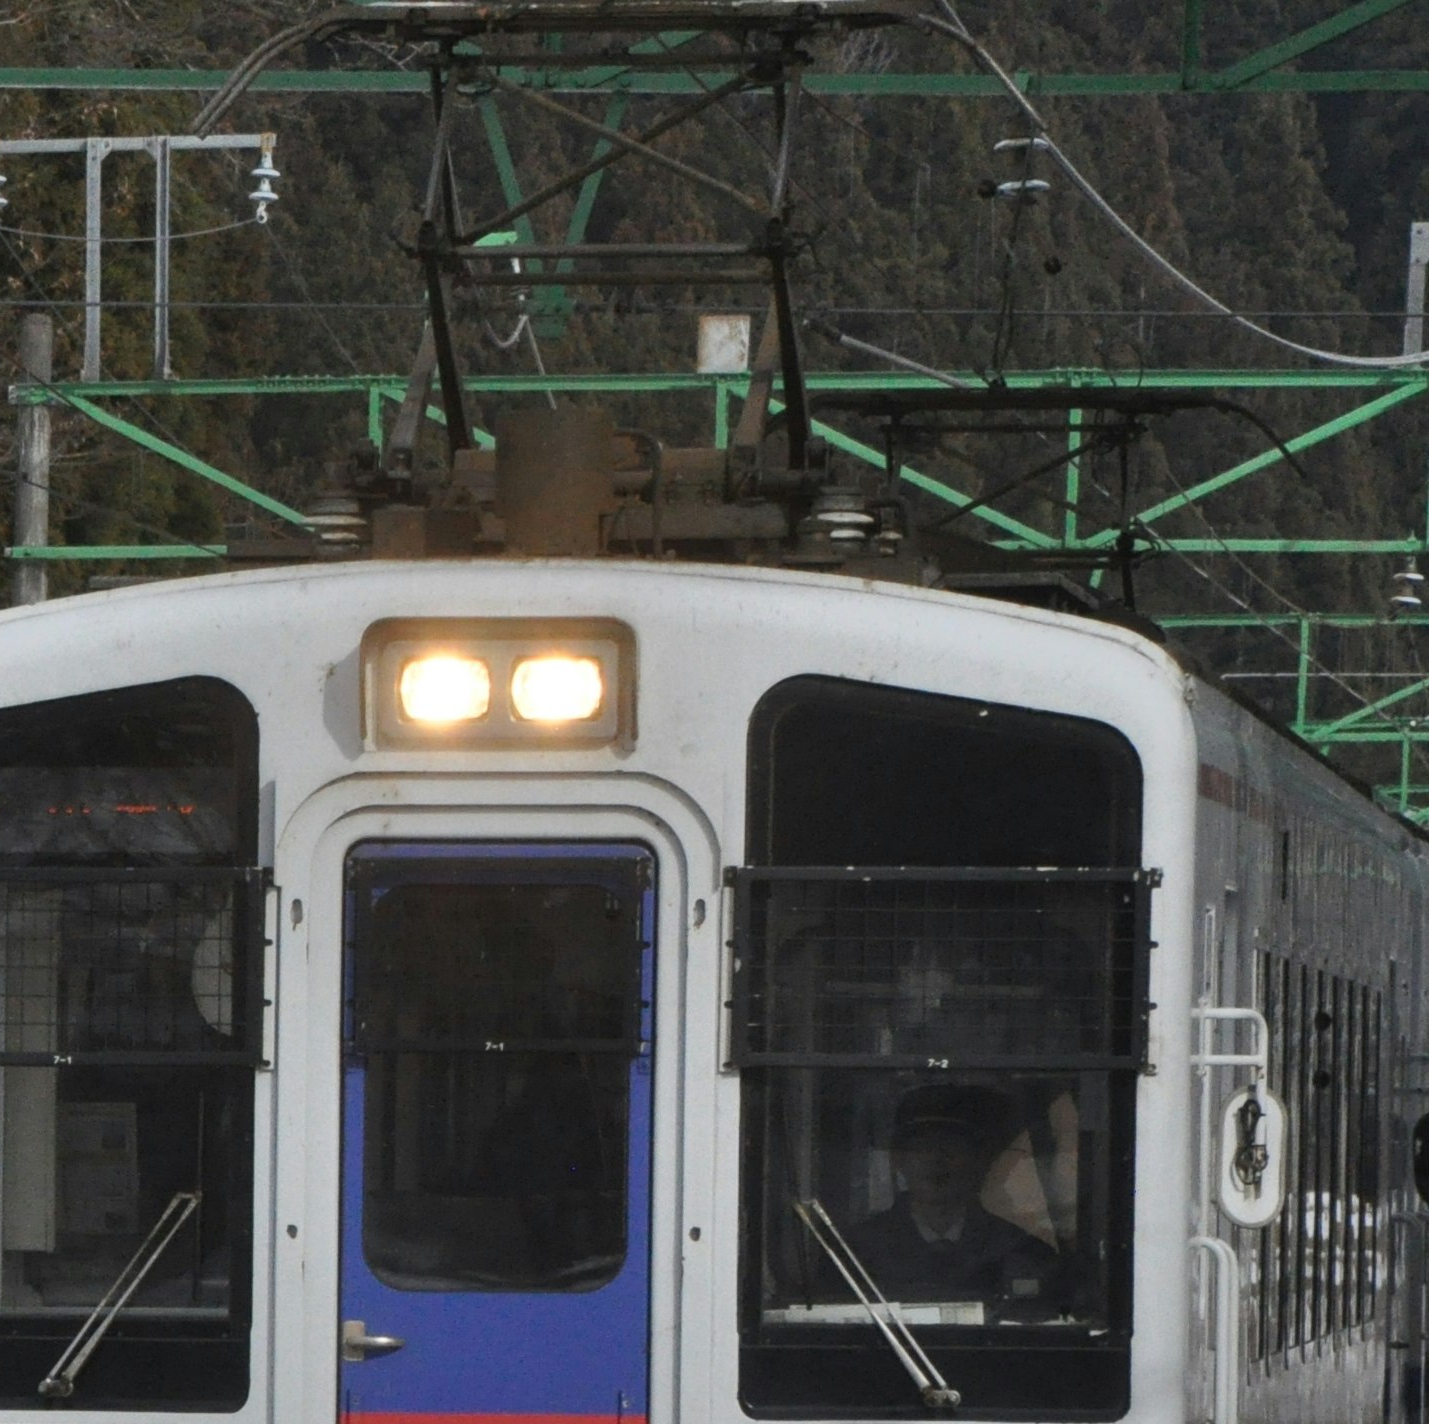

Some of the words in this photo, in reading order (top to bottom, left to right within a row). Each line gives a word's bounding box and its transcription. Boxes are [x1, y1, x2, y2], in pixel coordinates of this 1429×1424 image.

[485, 1041, 504, 1051] 7-1
[53, 1055, 72, 1065] 7-1
[927, 1058, 949, 1069] 7-2
